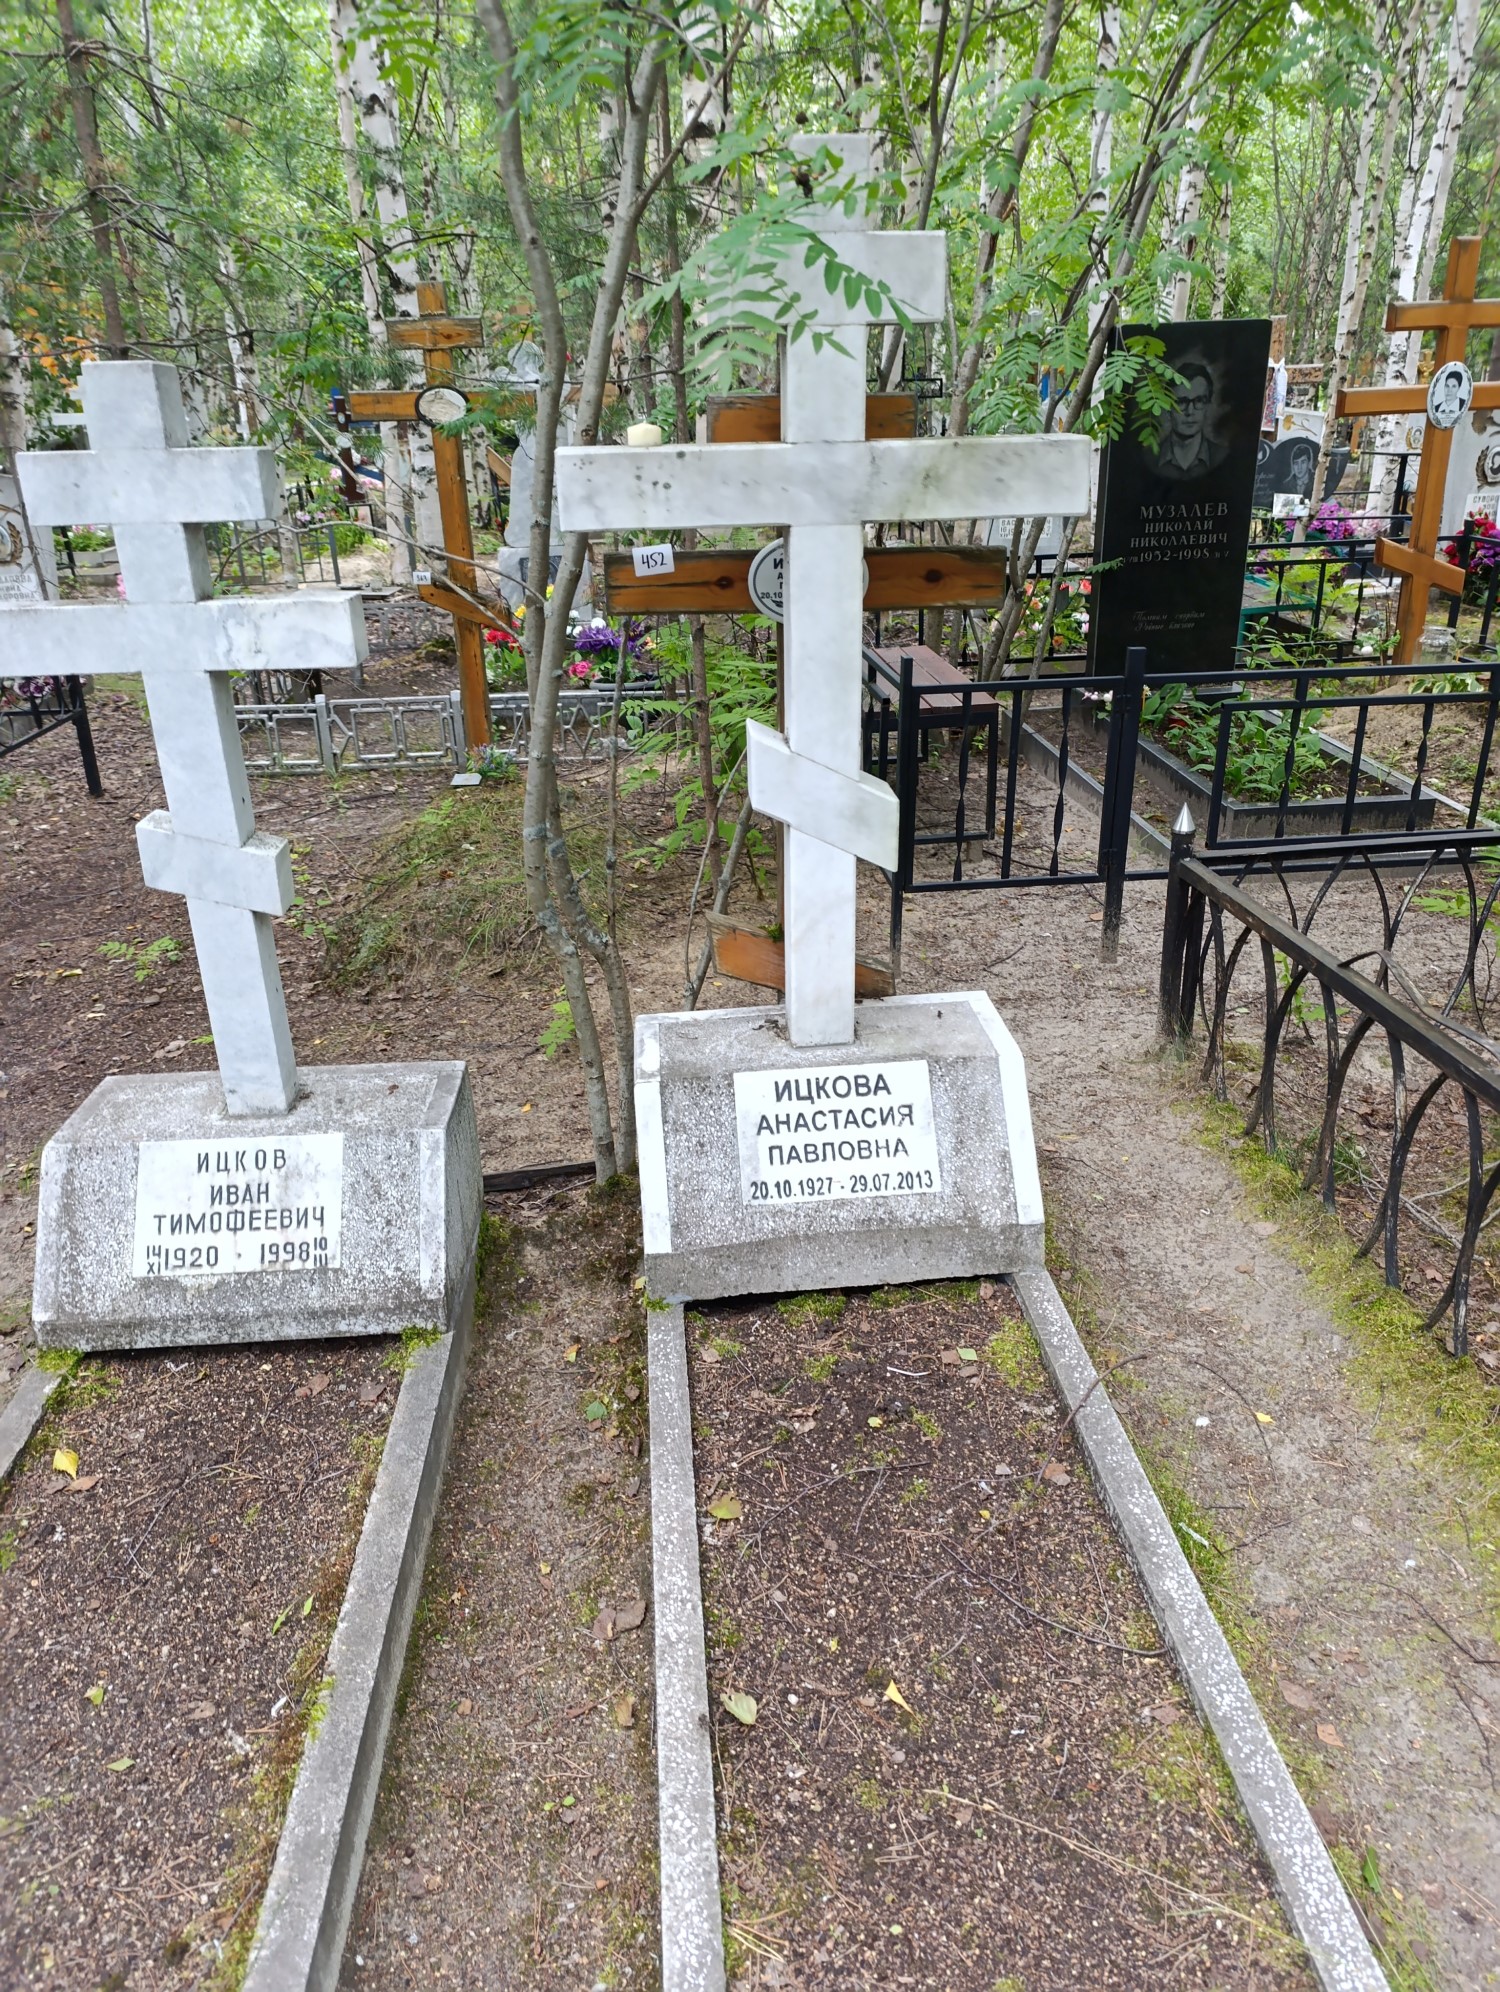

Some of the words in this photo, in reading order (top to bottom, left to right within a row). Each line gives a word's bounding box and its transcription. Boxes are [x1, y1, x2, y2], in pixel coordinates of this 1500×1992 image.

[1140, 502, 1228, 519] МУЗАЛЕВ
[1144, 518, 1213, 533] НИКОЛАЙ
[1130, 533, 1228, 548] НИКОЛАЕВИЧ
[641, 551, 668, 569] 452
[1140, 548, 1210, 563] 1952-1998
[774, 1073, 892, 1105] ИЦКОВА
[756, 1103, 915, 1136] АНАСТАСИЯ
[197, 1148, 287, 1175] ИЦКОВ
[768, 1137, 909, 1166] ПАВЛОВНА
[210, 1182, 270, 1206] ИВАН
[750, 1176, 834, 1200] 20.10.1927
[849, 1169, 934, 1193] 29.07.2013
[153, 1205, 325, 1236] ТИМОФЕЕВИЧ
[165, 1246, 219, 1271] 1920
[261, 1241, 310, 1265] 1998
